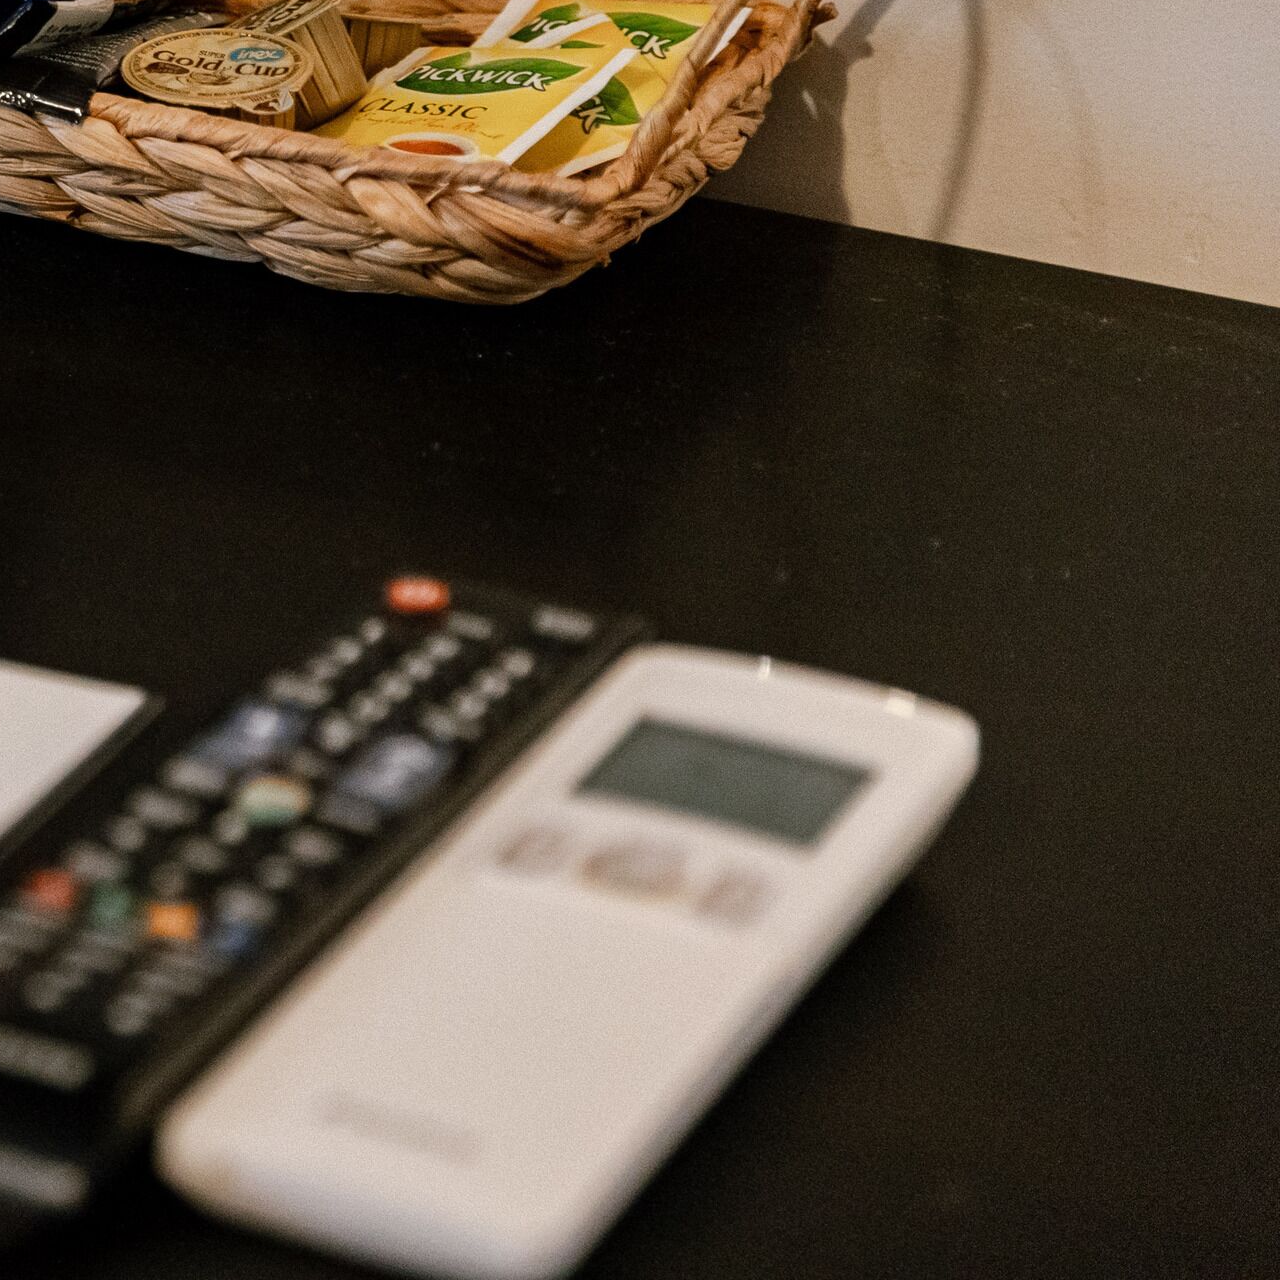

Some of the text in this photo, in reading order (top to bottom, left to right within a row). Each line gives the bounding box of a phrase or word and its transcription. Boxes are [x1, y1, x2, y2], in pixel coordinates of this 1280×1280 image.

[152, 49, 224, 72] Gold
[235, 62, 290, 77] Cup
[199, 49, 226, 59] SUPER
[400, 65, 551, 91] PICKWICK
[358, 97, 489, 120] CLASSIC
